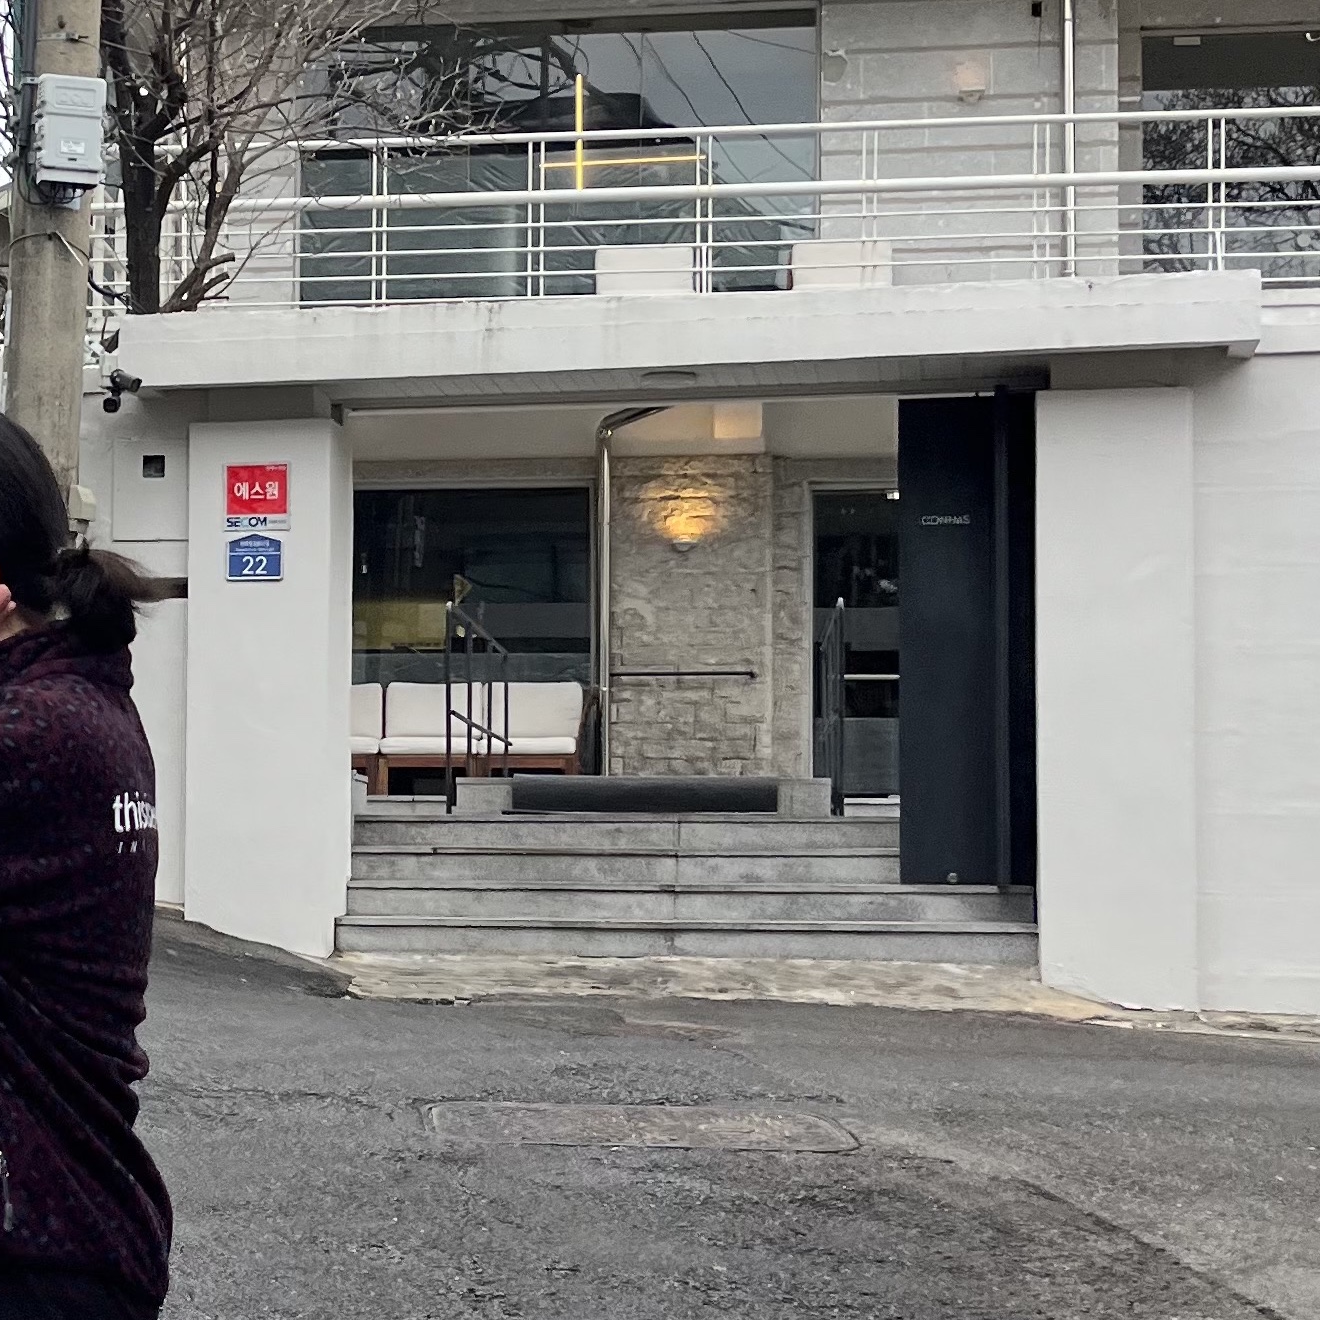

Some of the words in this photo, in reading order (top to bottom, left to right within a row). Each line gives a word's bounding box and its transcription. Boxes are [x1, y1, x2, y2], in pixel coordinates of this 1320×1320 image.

[234, 481, 279, 500] 에스원
[226, 516, 268, 528] SECOM
[242, 555, 268, 575] 22
